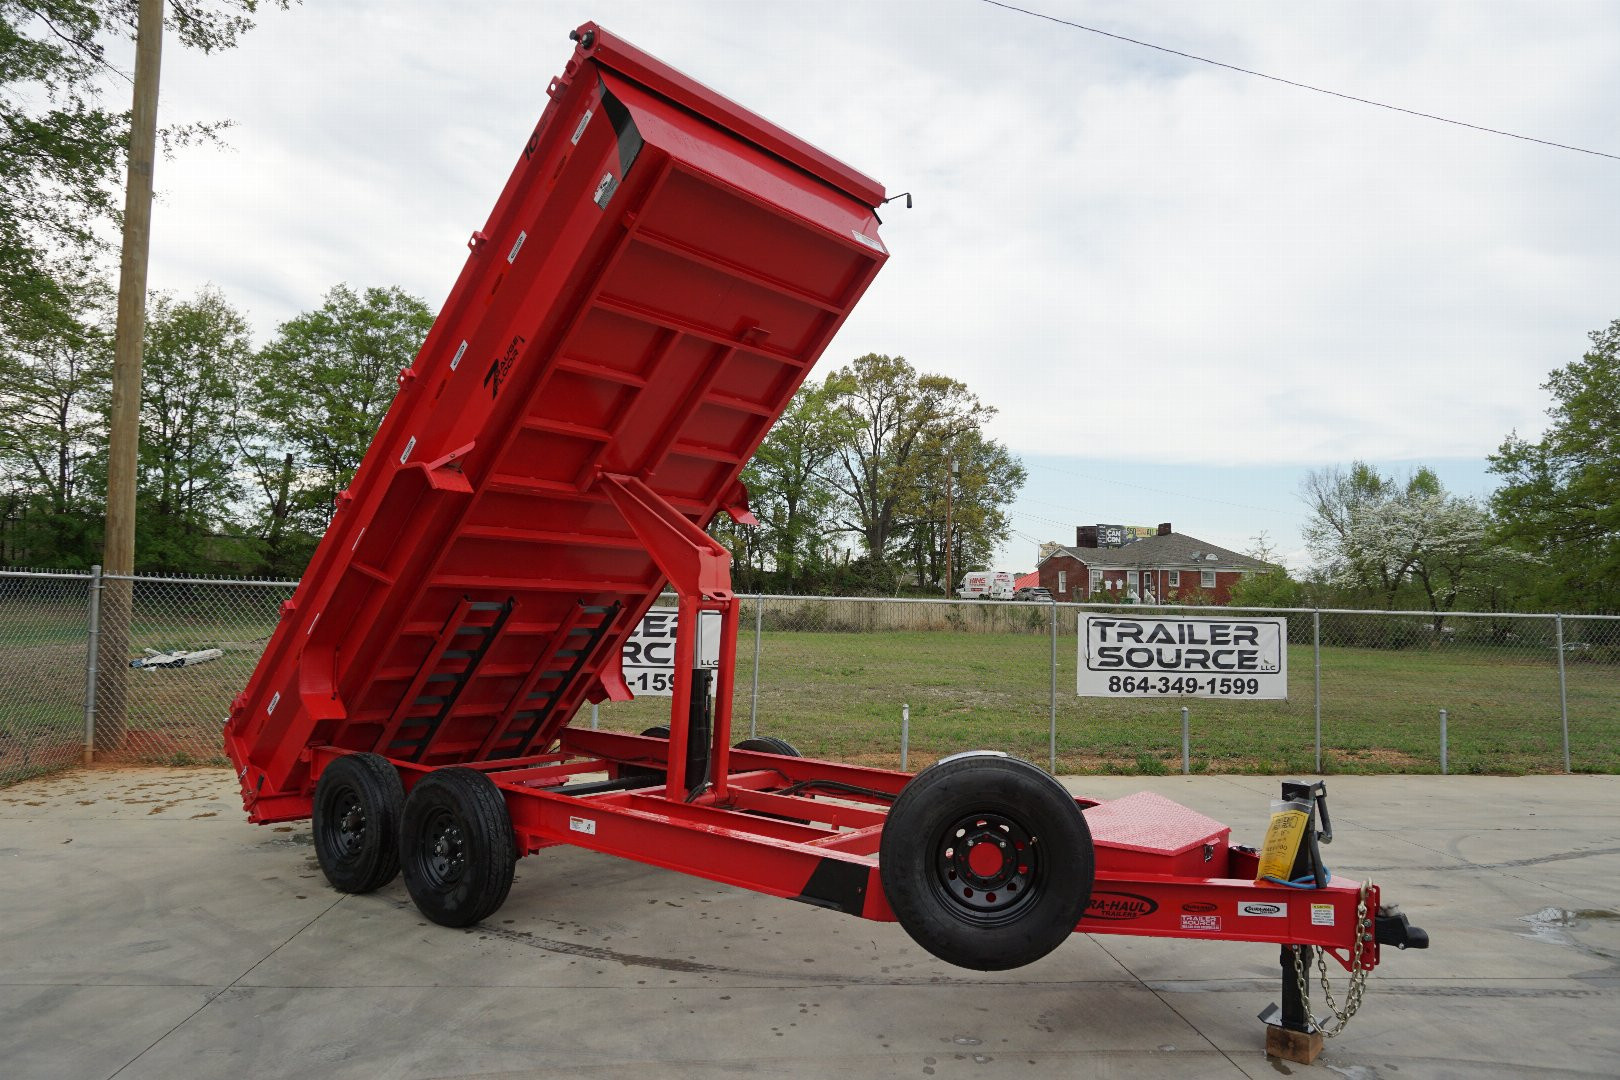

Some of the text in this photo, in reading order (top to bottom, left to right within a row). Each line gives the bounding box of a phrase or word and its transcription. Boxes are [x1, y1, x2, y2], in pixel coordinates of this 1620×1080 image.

[1092, 621, 1260, 646] TRAILER
[1097, 646, 1258, 670] SOURCE
[1108, 675, 1259, 695] 864-349-1599
